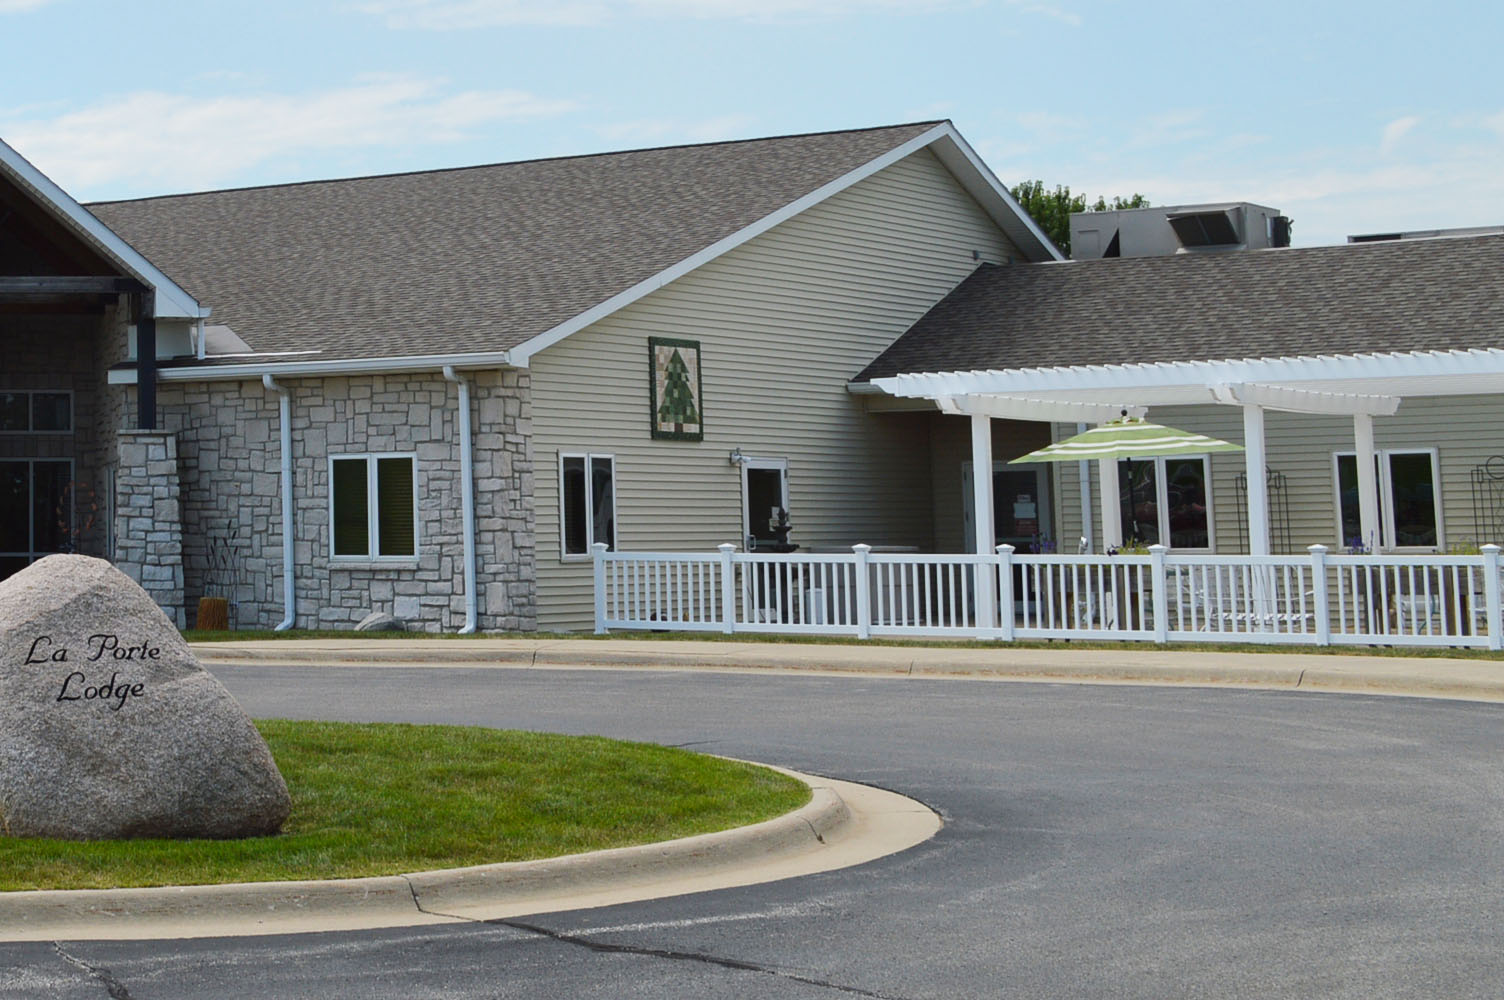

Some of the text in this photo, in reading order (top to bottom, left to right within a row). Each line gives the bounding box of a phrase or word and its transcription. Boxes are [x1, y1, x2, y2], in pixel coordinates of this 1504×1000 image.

[24, 634, 161, 665] La Porte
[56, 672, 146, 711] Lodge
